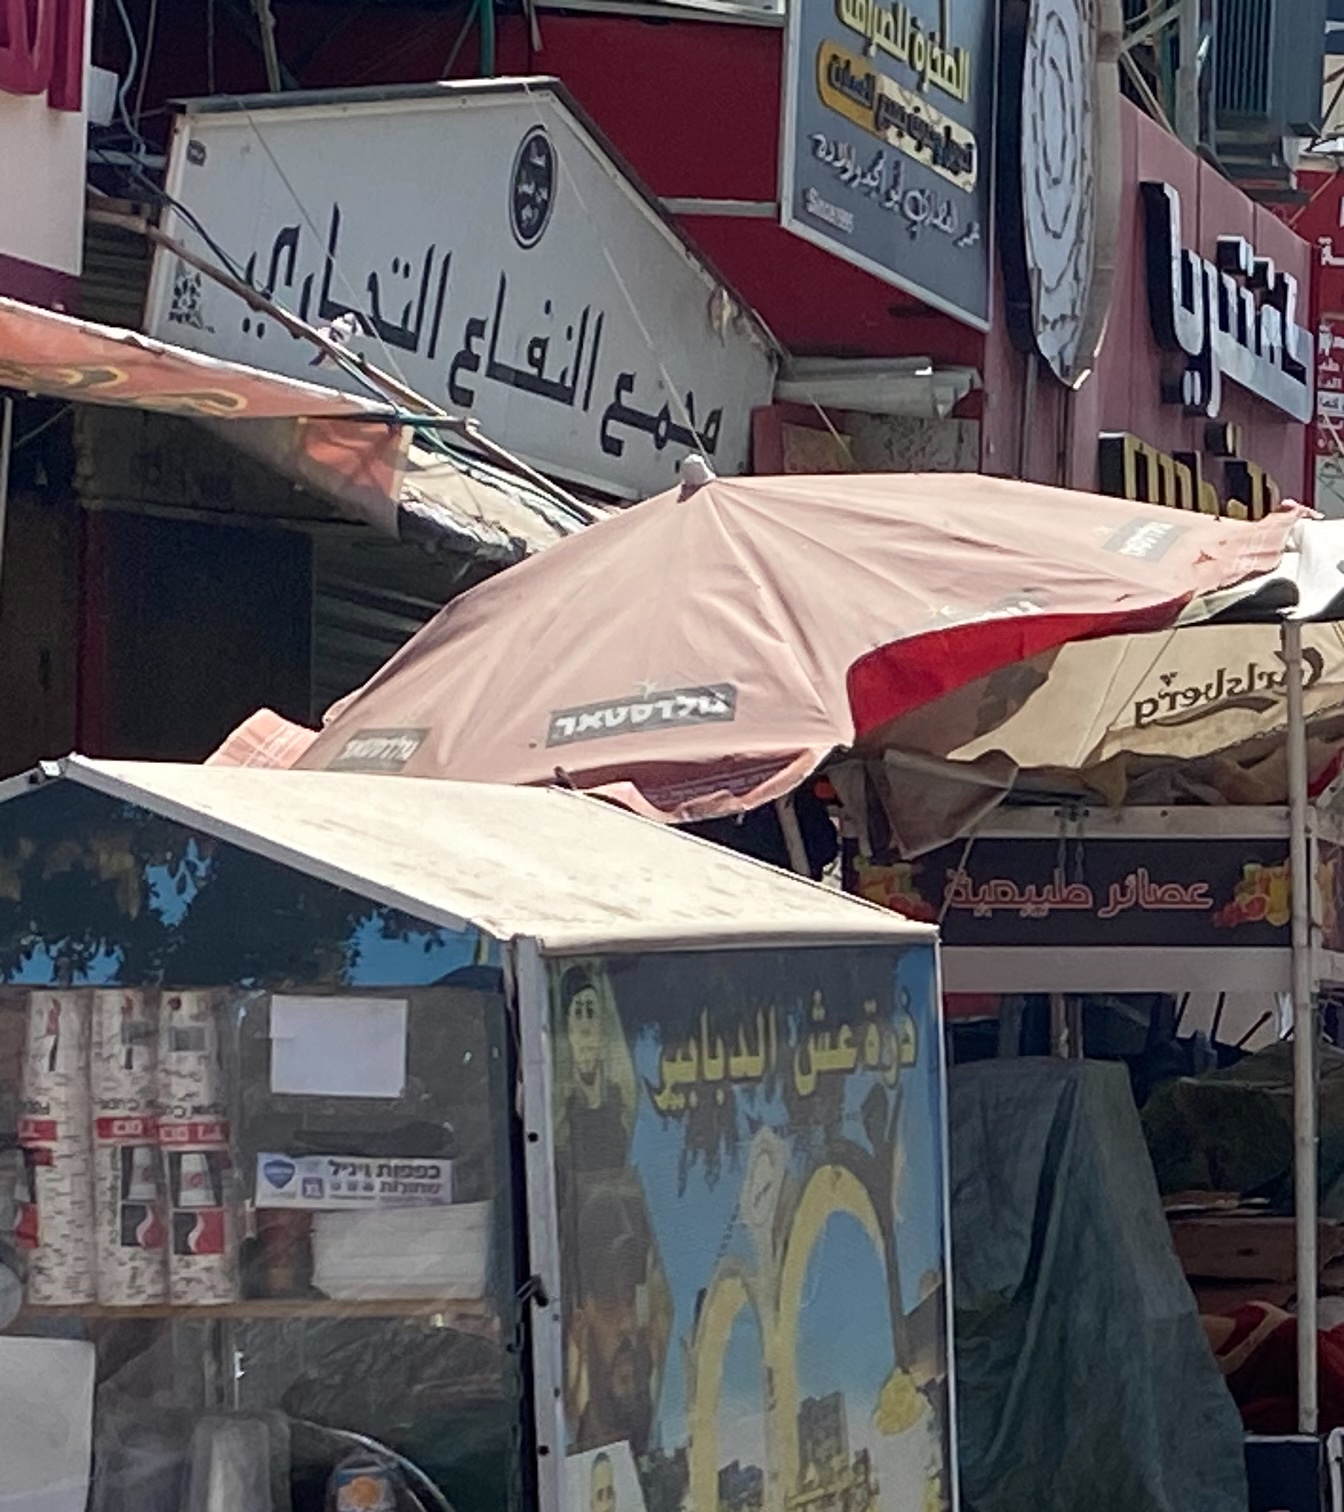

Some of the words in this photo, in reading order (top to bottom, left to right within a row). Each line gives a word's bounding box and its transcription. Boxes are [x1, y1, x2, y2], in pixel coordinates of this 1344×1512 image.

[553, 691, 731, 740] גולדסטאר
[944, 867, 1095, 918] طبيعية
[1099, 868, 1215, 918] عصائر
